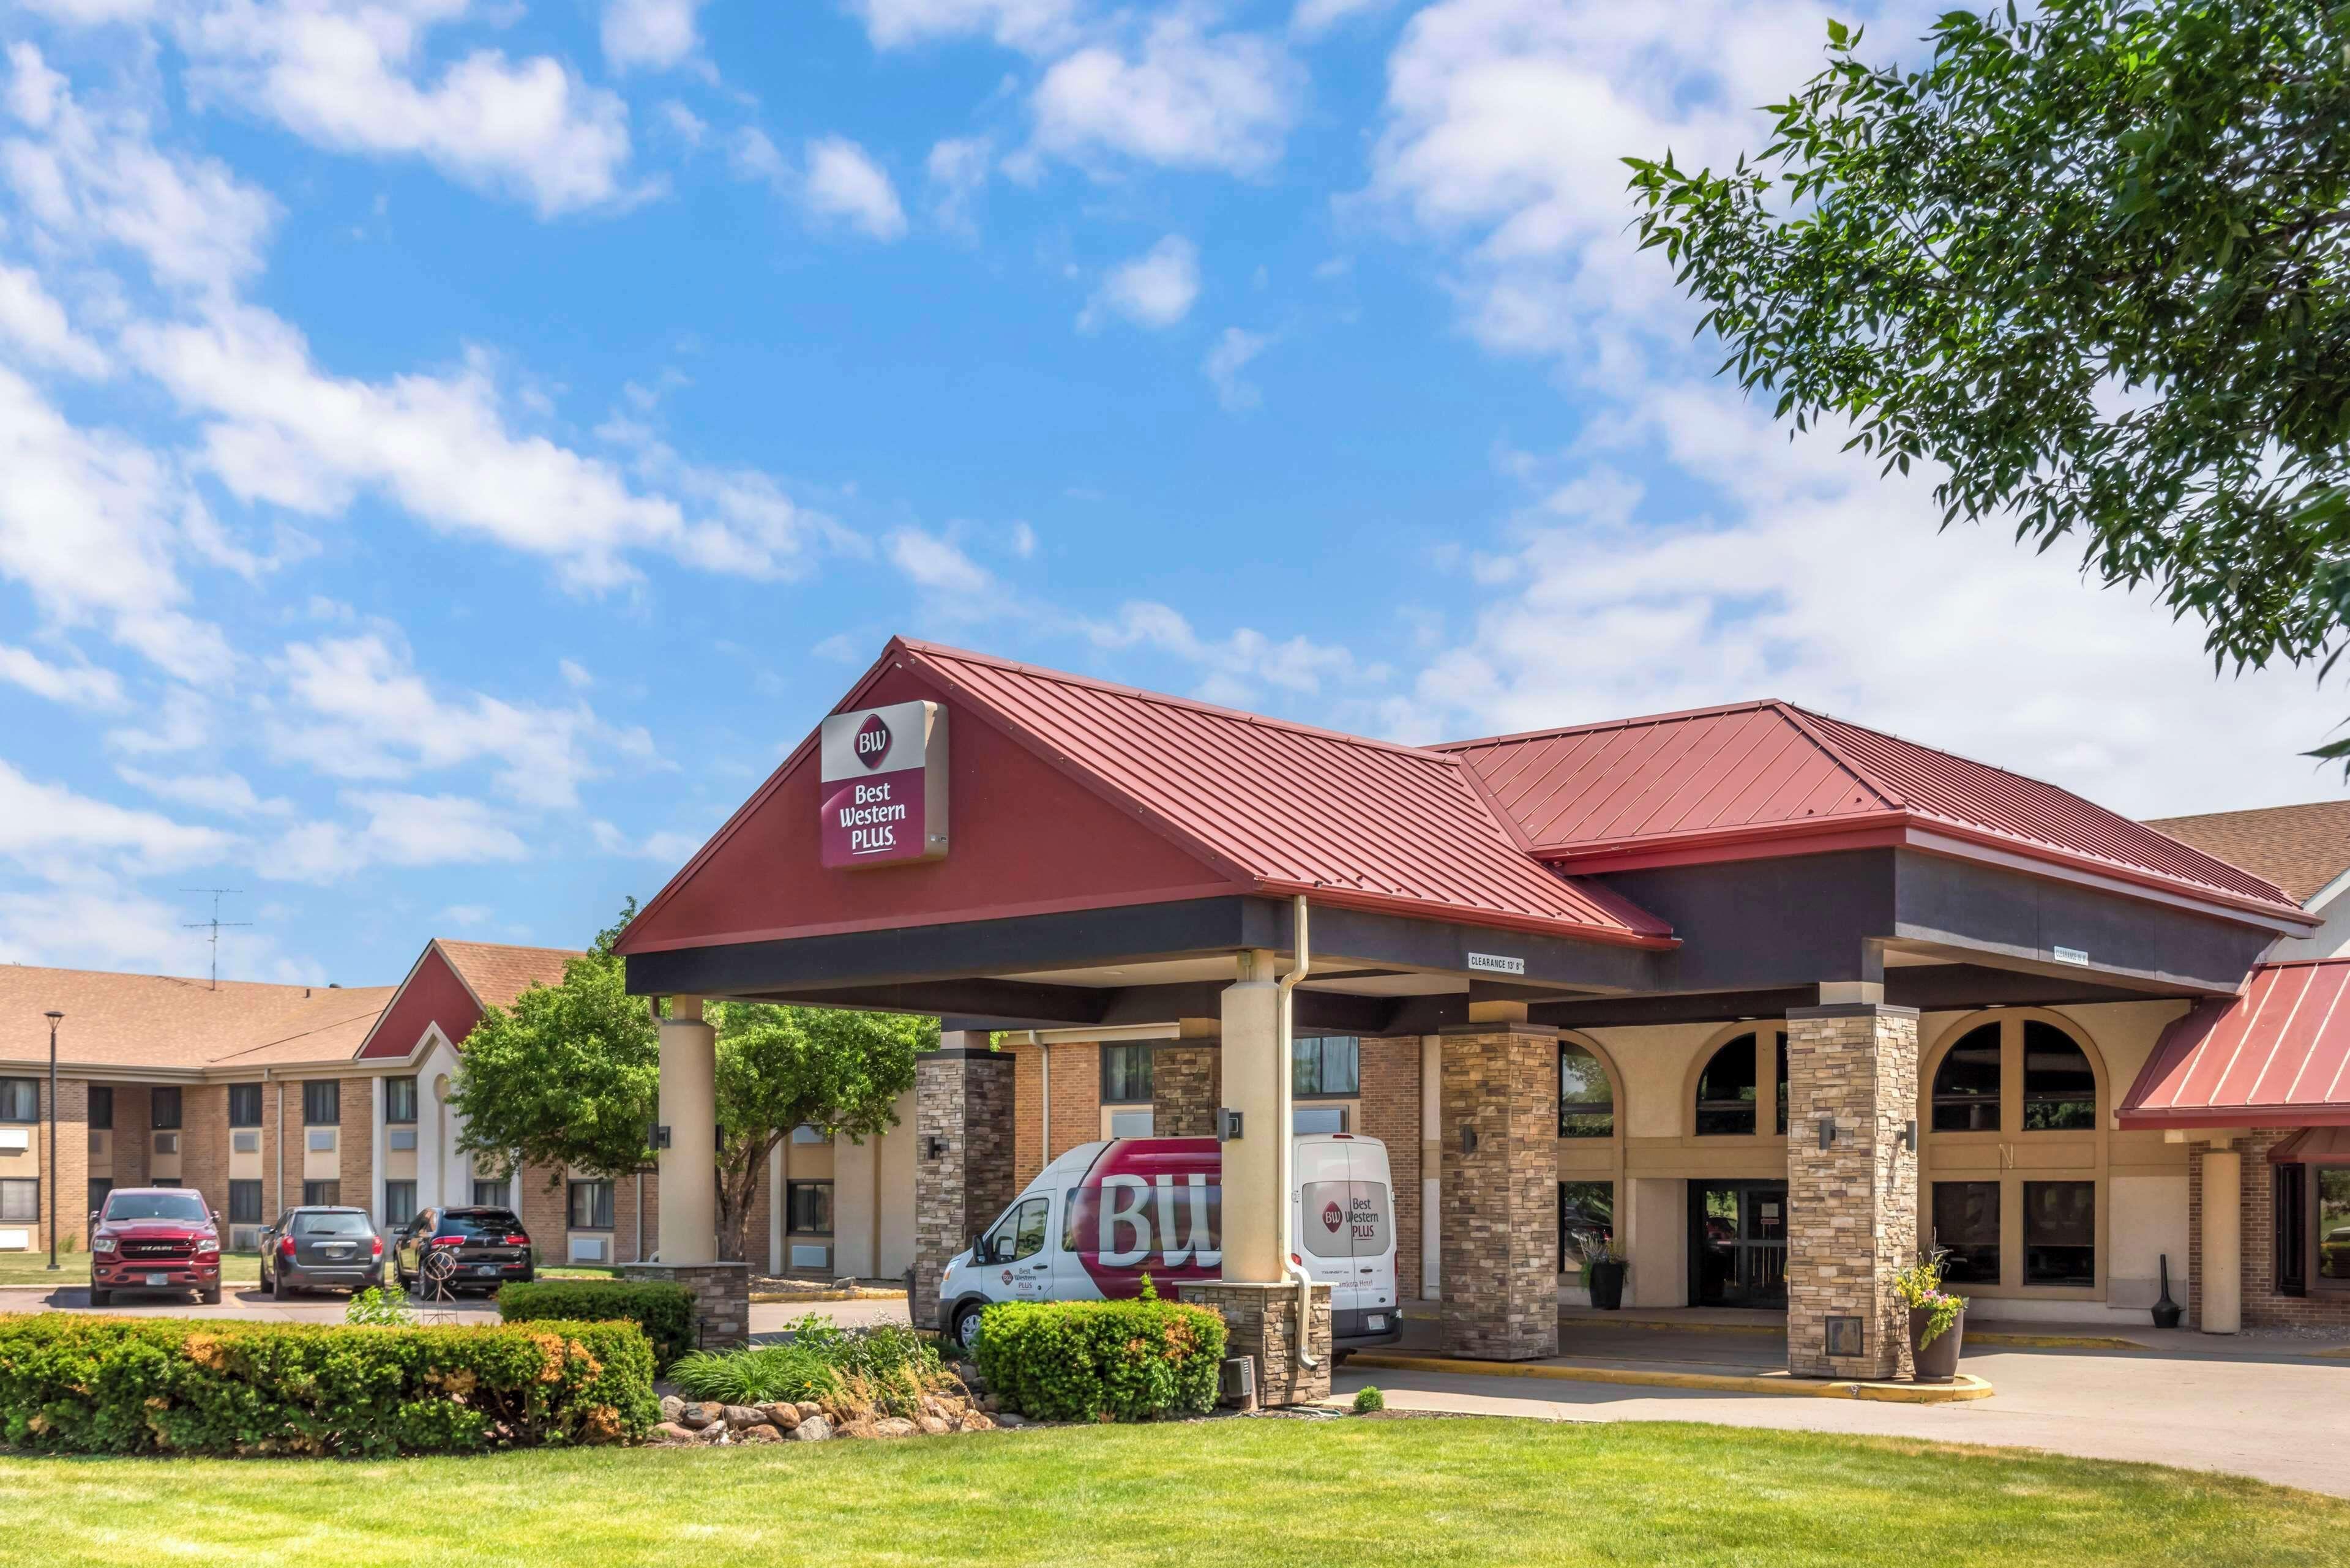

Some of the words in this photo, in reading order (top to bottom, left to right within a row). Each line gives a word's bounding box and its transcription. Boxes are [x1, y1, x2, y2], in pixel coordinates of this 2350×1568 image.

[859, 730, 886, 753] BW
[855, 783, 891, 804] Best
[840, 804, 906, 827] Western
[1471, 957, 1506, 969] CLEARANCE
[1352, 1198, 1371, 1209] Best
[1325, 1211, 1341, 1223] BW
[1345, 1211, 1379, 1223] Western
[1352, 1225, 1374, 1237] PLUS
